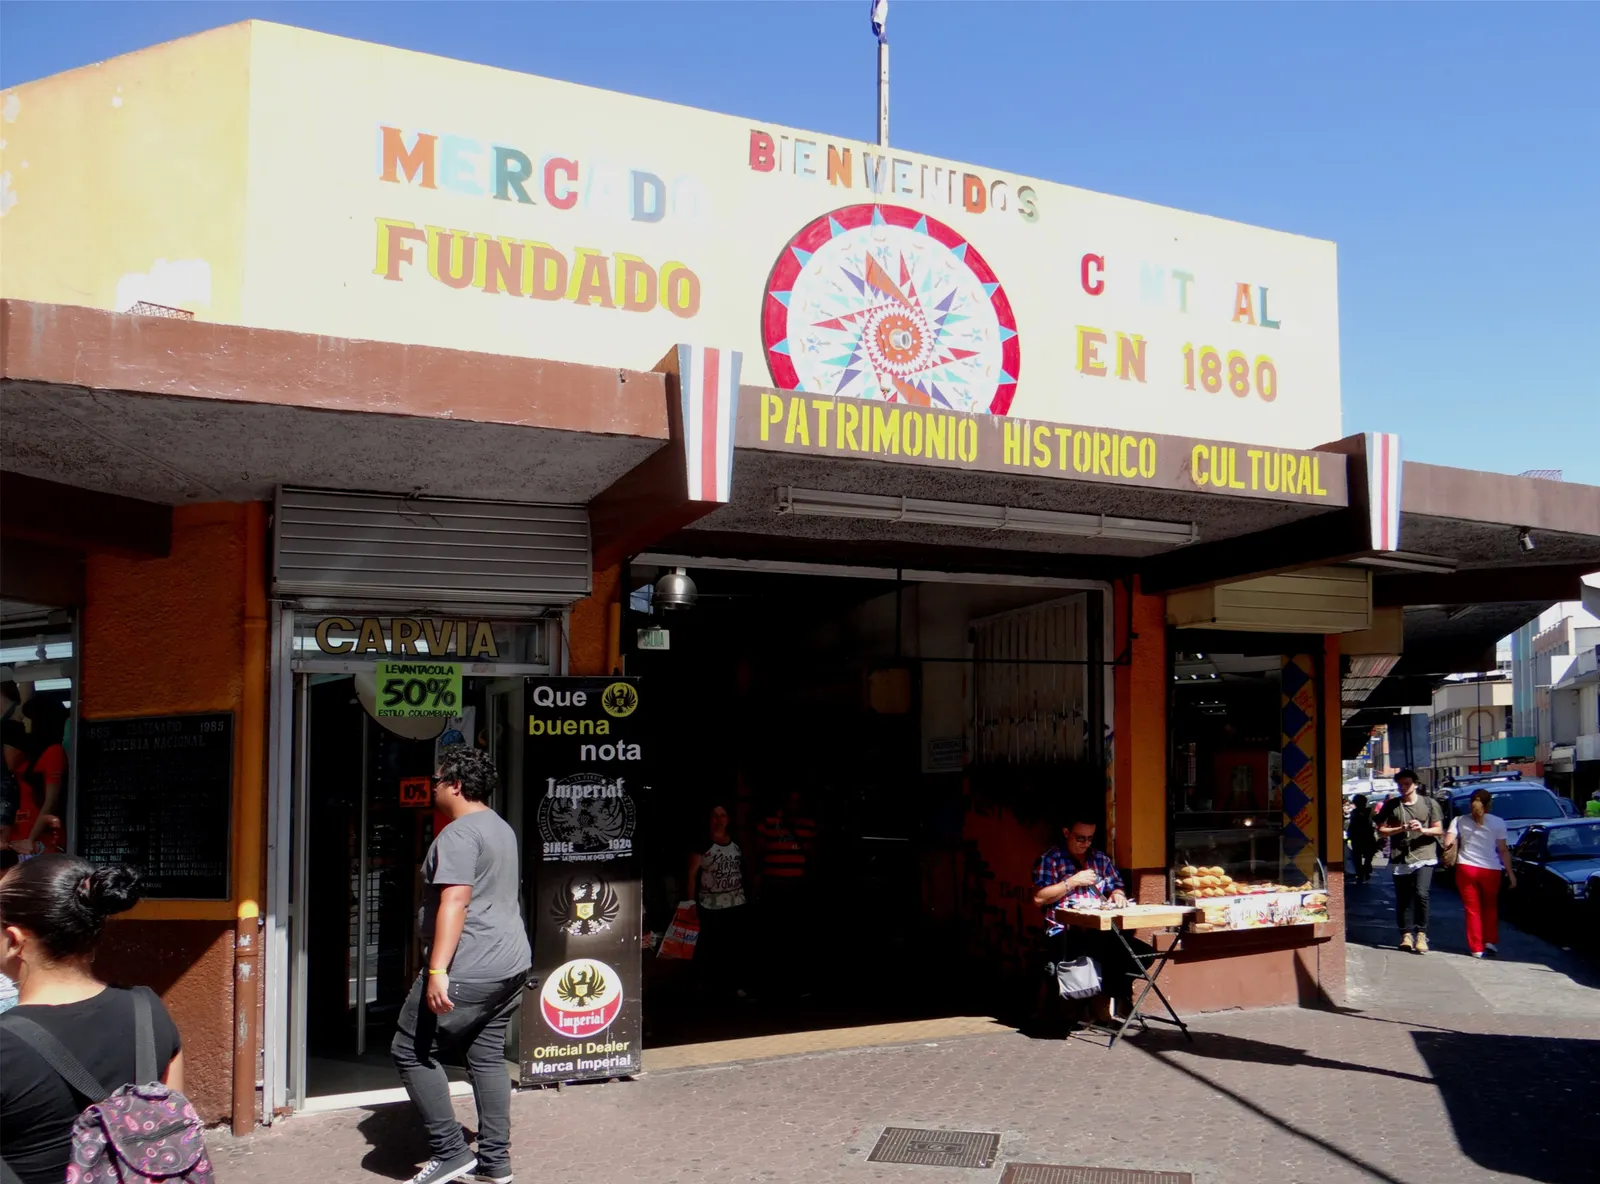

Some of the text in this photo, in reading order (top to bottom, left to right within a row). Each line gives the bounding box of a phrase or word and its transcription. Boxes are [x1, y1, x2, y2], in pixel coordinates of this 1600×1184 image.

[376, 123, 711, 229] MERCADO
[749, 129, 1039, 223] BIENVENIDOS
[373, 217, 1278, 402] FUNDADO EN 1880
[761, 393, 1327, 497] PATRIMONIO HISTORICO CULTURAL
[315, 616, 500, 657] CARVIA
[385, 664, 454, 675] LEVANTACOLA
[382, 678, 456, 708] 50%
[533, 686, 587, 708] Que
[378, 709, 458, 717] ESTILO COLOMBIANO
[200, 721, 224, 732] 1985
[529, 715, 610, 735] buena
[581, 739, 641, 761] nota
[545, 777, 626, 810] Imperial
[543, 838, 632, 853] SINCE 1924
[558, 1007, 605, 1034] Imperial
[534, 1040, 630, 1059] Official Dealer
[532, 1054, 631, 1074] Marca Imperial
